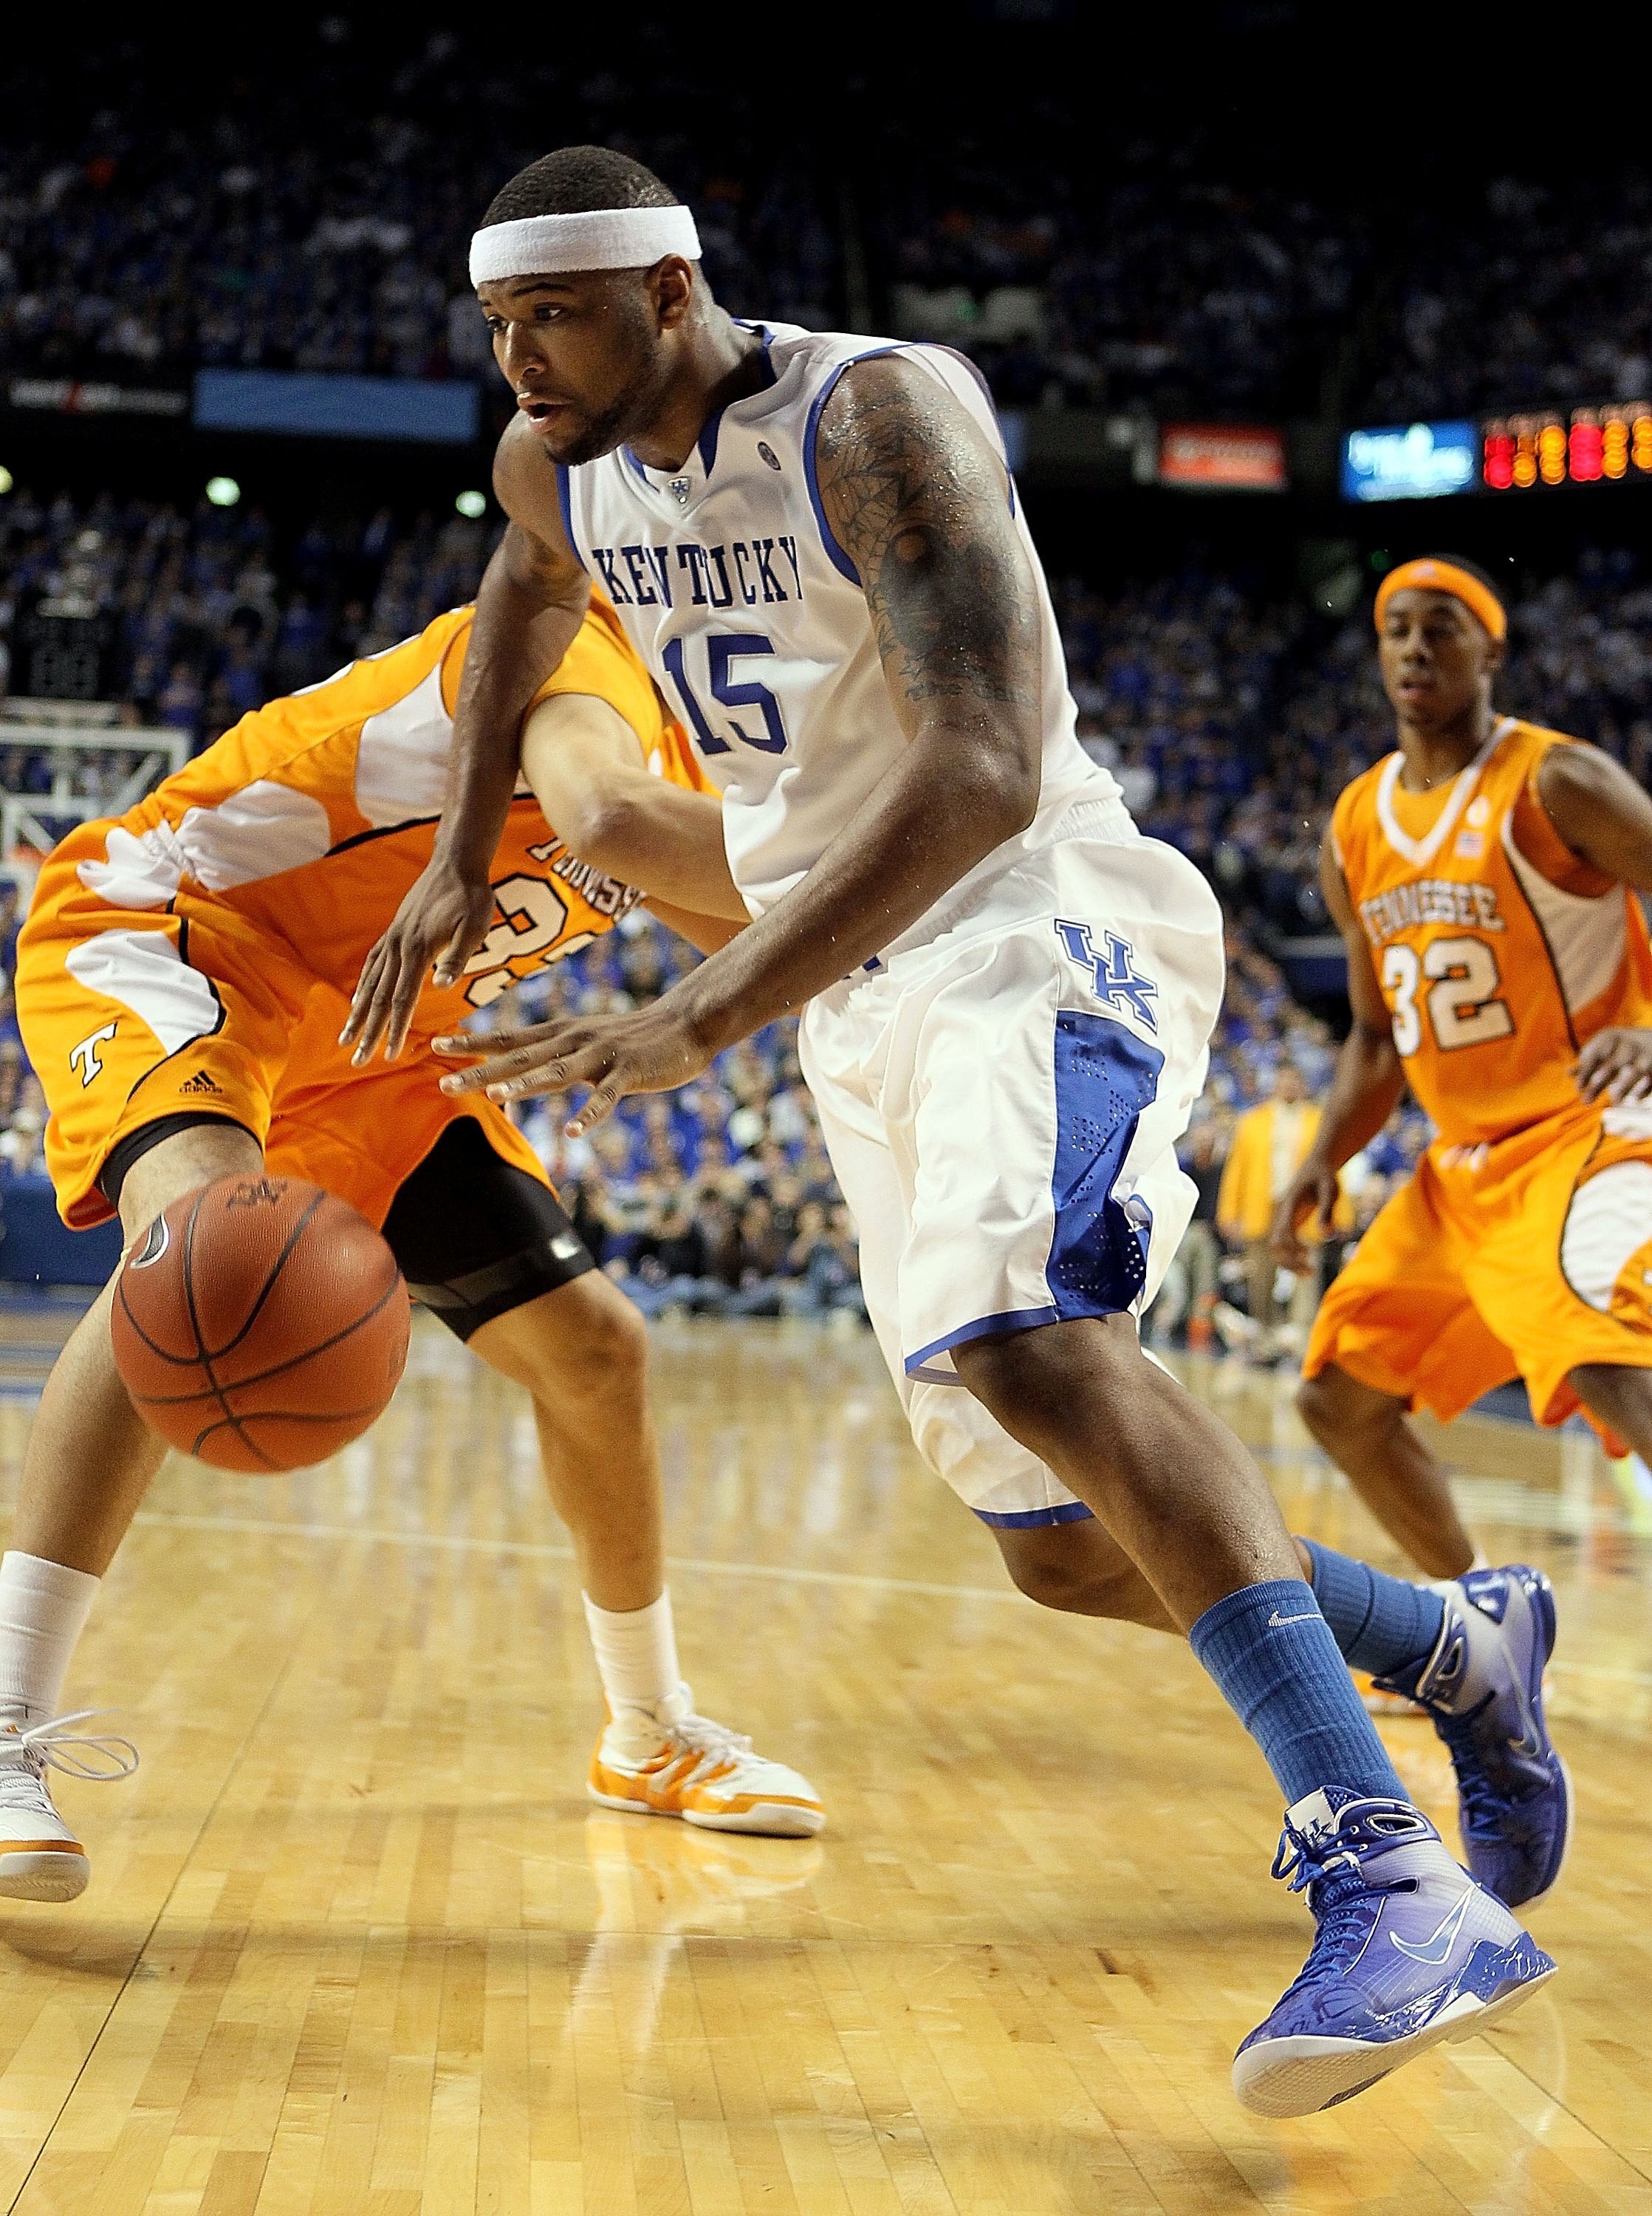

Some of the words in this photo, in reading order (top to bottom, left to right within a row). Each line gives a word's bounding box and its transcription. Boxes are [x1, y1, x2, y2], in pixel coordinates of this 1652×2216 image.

[662, 633, 788, 756] 15
[1054, 918, 1159, 1036] UK
[1382, 936, 1515, 1057] 32
[69, 1022, 118, 1088] T
